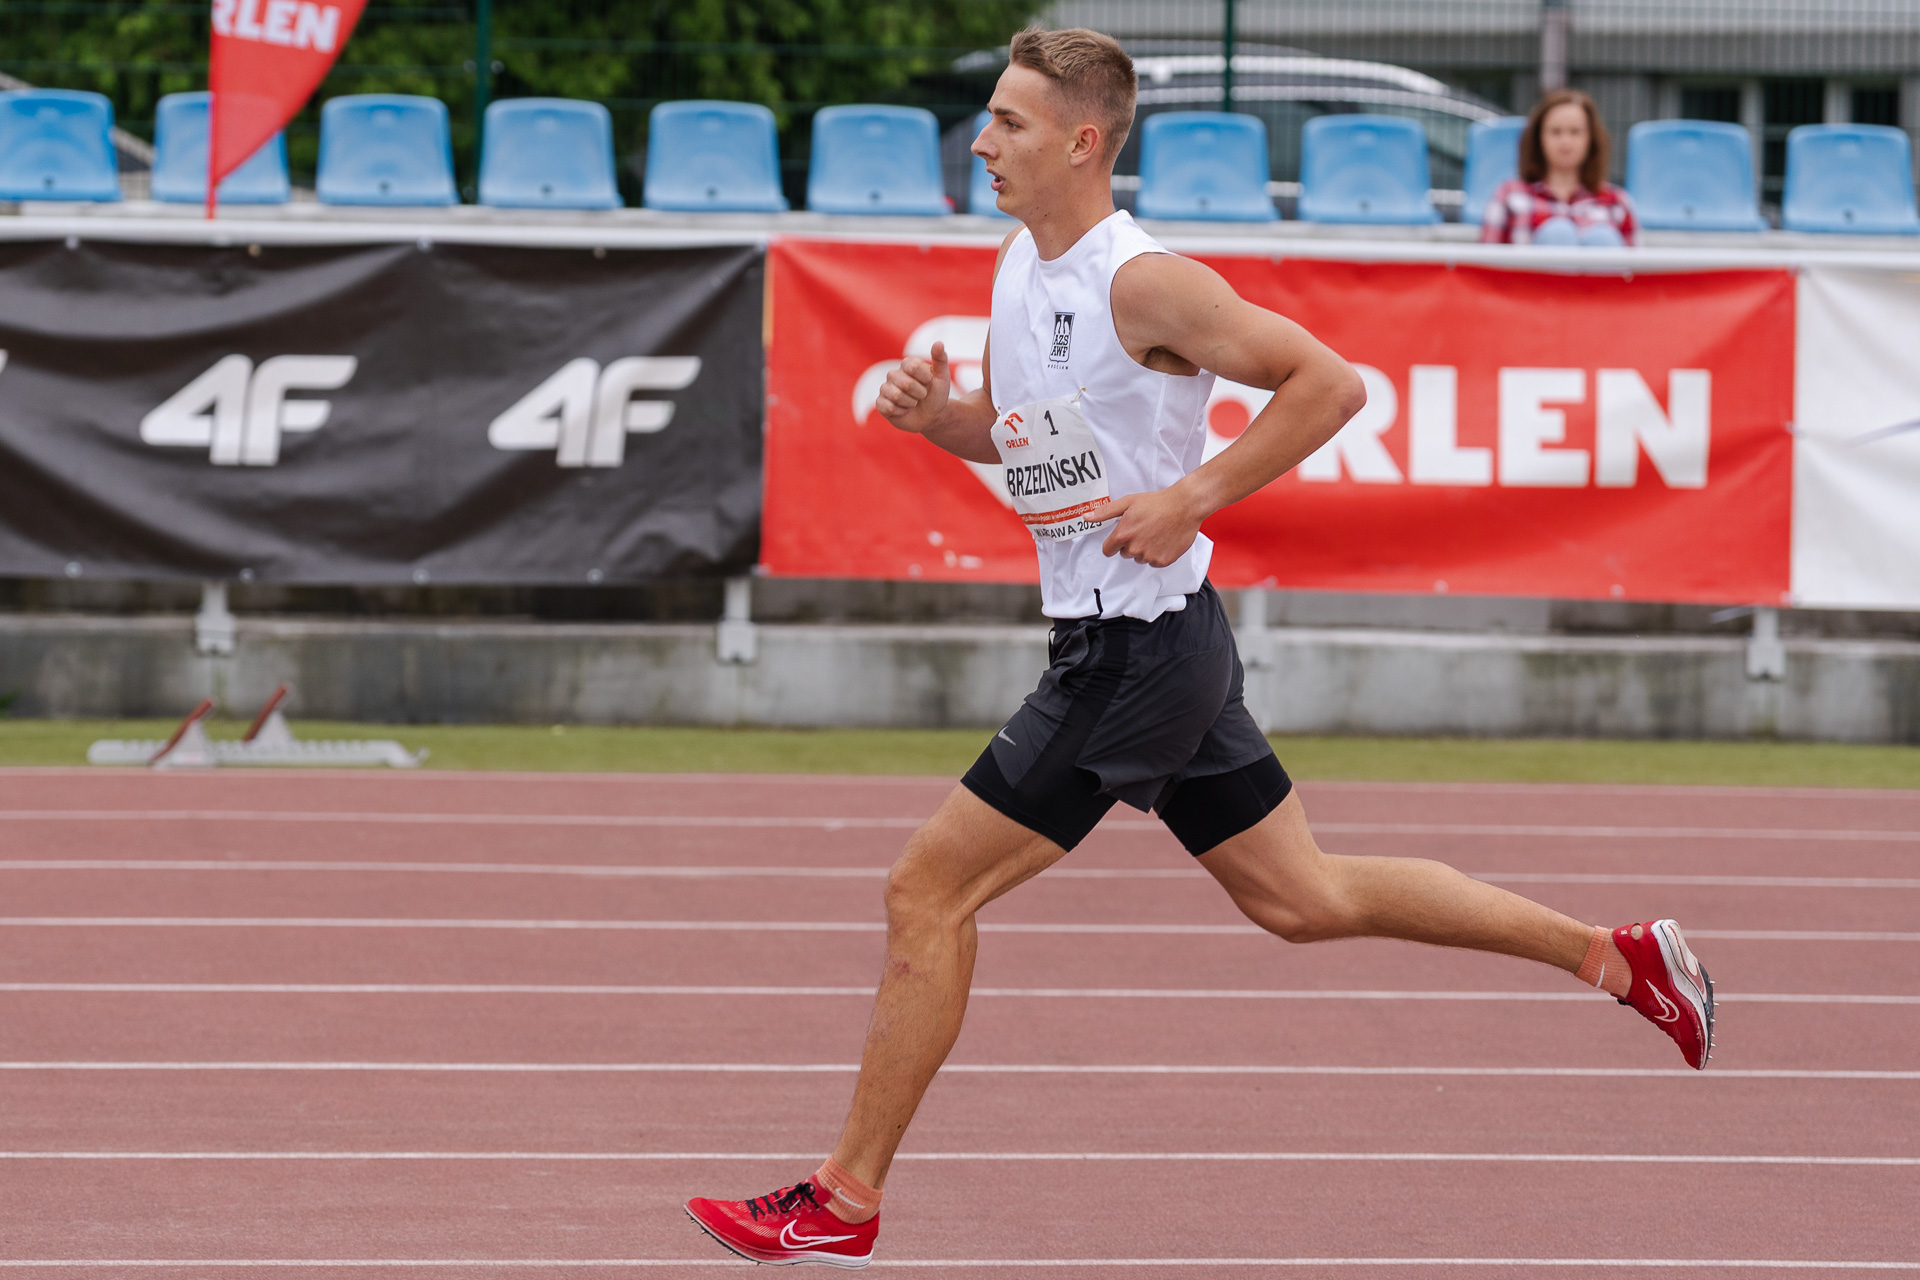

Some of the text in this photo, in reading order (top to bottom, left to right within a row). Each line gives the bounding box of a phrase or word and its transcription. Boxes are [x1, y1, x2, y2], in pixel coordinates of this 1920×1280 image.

[1050, 345, 1068, 357] AWF
[1053, 334, 1069, 346] AZS
[140, 354, 358, 466] 4F
[488, 356, 701, 468] 4F
[1043, 409, 1059, 436] 1
[1005, 436, 1030, 449] ORLEN
[1006, 450, 1102, 497] BRZEZIŃSKI
